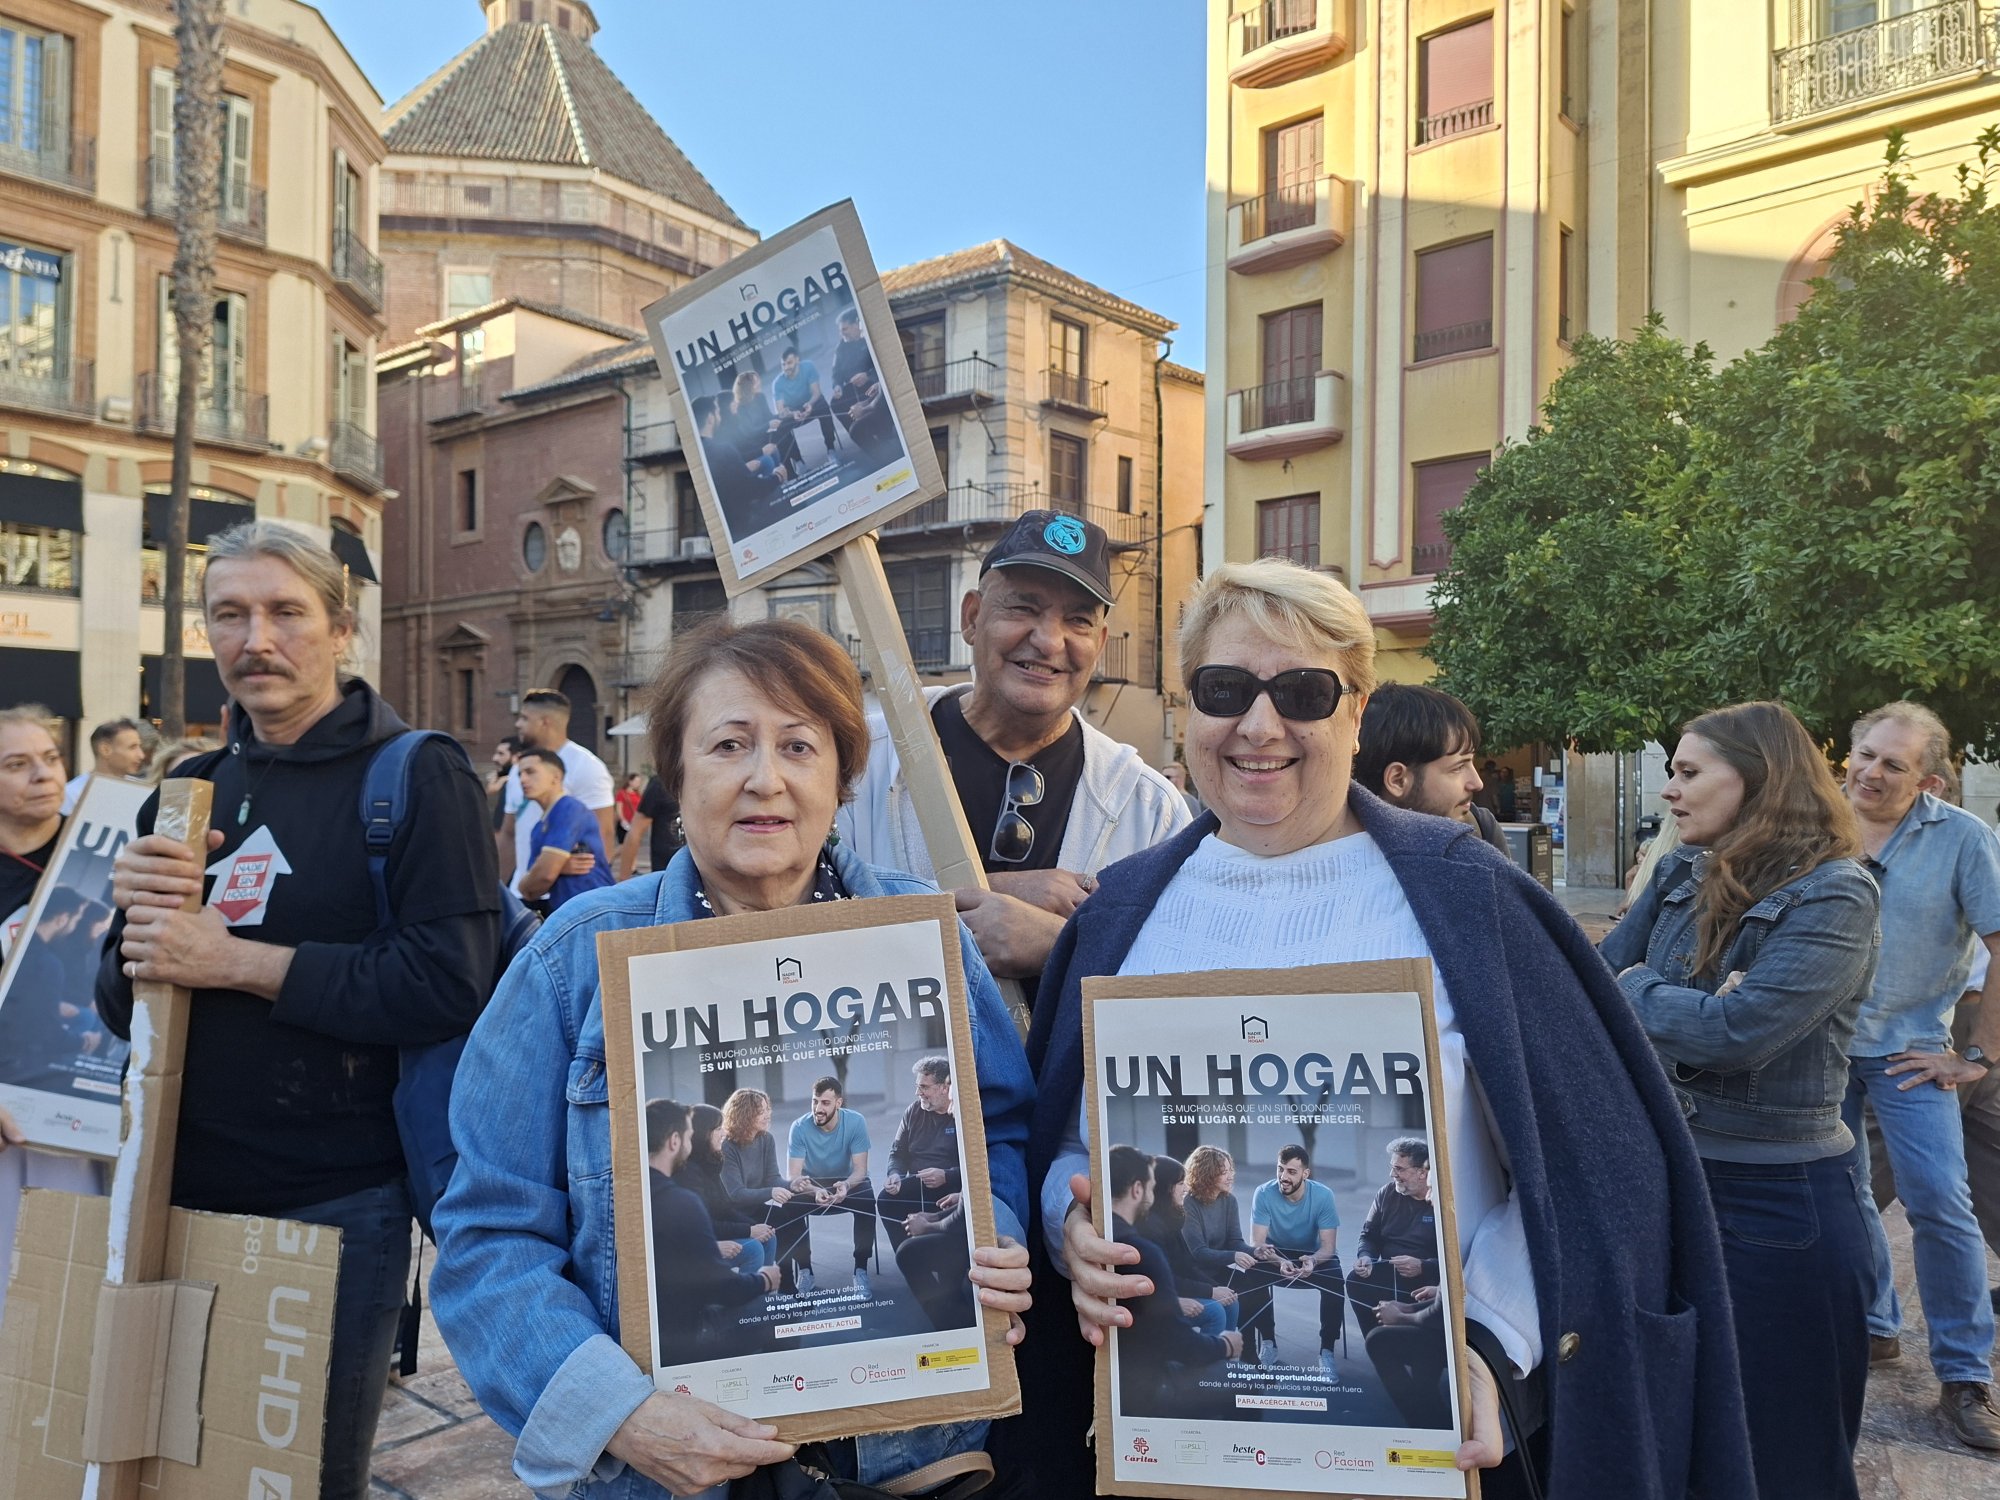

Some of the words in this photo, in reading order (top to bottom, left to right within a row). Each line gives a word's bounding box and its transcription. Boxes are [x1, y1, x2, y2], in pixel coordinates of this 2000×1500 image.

[675, 329, 722, 371] UN
[728, 261, 851, 344] HOGAR
[641, 1004, 722, 1052] UN
[743, 977, 943, 1038] HOGAR
[699, 1053, 711, 1062] ES
[714, 1048, 748, 1060] MUCHO
[750, 1044, 770, 1056] MÁS
[772, 1042, 791, 1052] QUE
[793, 1040, 806, 1050] UN
[808, 1037, 832, 1048] SITIO
[834, 1033, 866, 1045] DONDE
[868, 1030, 892, 1042] VIVIR,
[700, 1062, 714, 1072] ES
[717, 1060, 733, 1071] UN
[736, 1056, 772, 1068] LUGAR
[776, 1053, 790, 1062] AL
[792, 1051, 816, 1061] QUE
[818, 1040, 892, 1057] PERTENECER.
[1105, 1055, 1183, 1097] UN
[1206, 1052, 1423, 1096] HOGAR
[1161, 1104, 1174, 1113] ES
[1176, 1104, 1210, 1113] MUCHO
[1212, 1102, 1234, 1113] MÁS
[1236, 1104, 1256, 1113] QUE
[1258, 1104, 1272, 1112] UN
[1274, 1104, 1298, 1112] SITIO
[1300, 1104, 1334, 1112] DONDE
[1336, 1104, 1364, 1114] VIVIR,
[1162, 1116, 1176, 1124] ES
[1180, 1116, 1195, 1124] UN
[1198, 1116, 1236, 1124] LUGAR
[1240, 1116, 1254, 1124] AL
[1257, 1116, 1281, 1124] QUE
[1284, 1116, 1366, 1124] PERTENECER.
[776, 1293, 794, 1302] lugar
[796, 1290, 804, 1299] de
[806, 1288, 836, 1298] escucha
[766, 1304, 776, 1312] de
[777, 1301, 812, 1312] segundas
[813, 1294, 866, 1307] oportunidades,
[738, 1316, 762, 1325] donde
[762, 1314, 770, 1322] el
[770, 1312, 786, 1321] odio
[792, 1310, 803, 1318] los
[804, 1306, 837, 1318] prejuicios
[848, 1302, 874, 1311] queden
[875, 1298, 896, 1307] fuera.
[798, 1322, 834, 1332] ACÉRCATE.
[257, 1286, 310, 1449] UHD
[1238, 1362, 1256, 1372] lugar
[1268, 1364, 1300, 1372] escucha
[772, 1373, 795, 1384] beste
[868, 1368, 906, 1379] Faciam
[1238, 1372, 1274, 1381] segundas
[1275, 1374, 1333, 1384] oportunidades,
[1199, 1380, 1222, 1388] donde
[1254, 1382, 1265, 1390] los
[1266, 1384, 1301, 1392] prejuicios
[1312, 1384, 1341, 1393] queden
[1342, 1386, 1364, 1394] fuera.
[1260, 1398, 1300, 1406] ACÉRCATE.
[1300, 1399, 1326, 1408] ACTÚA.
[1232, 1444, 1256, 1454] beste
[1124, 1454, 1158, 1464] Cáritas
[1334, 1456, 1374, 1468] Faciam
